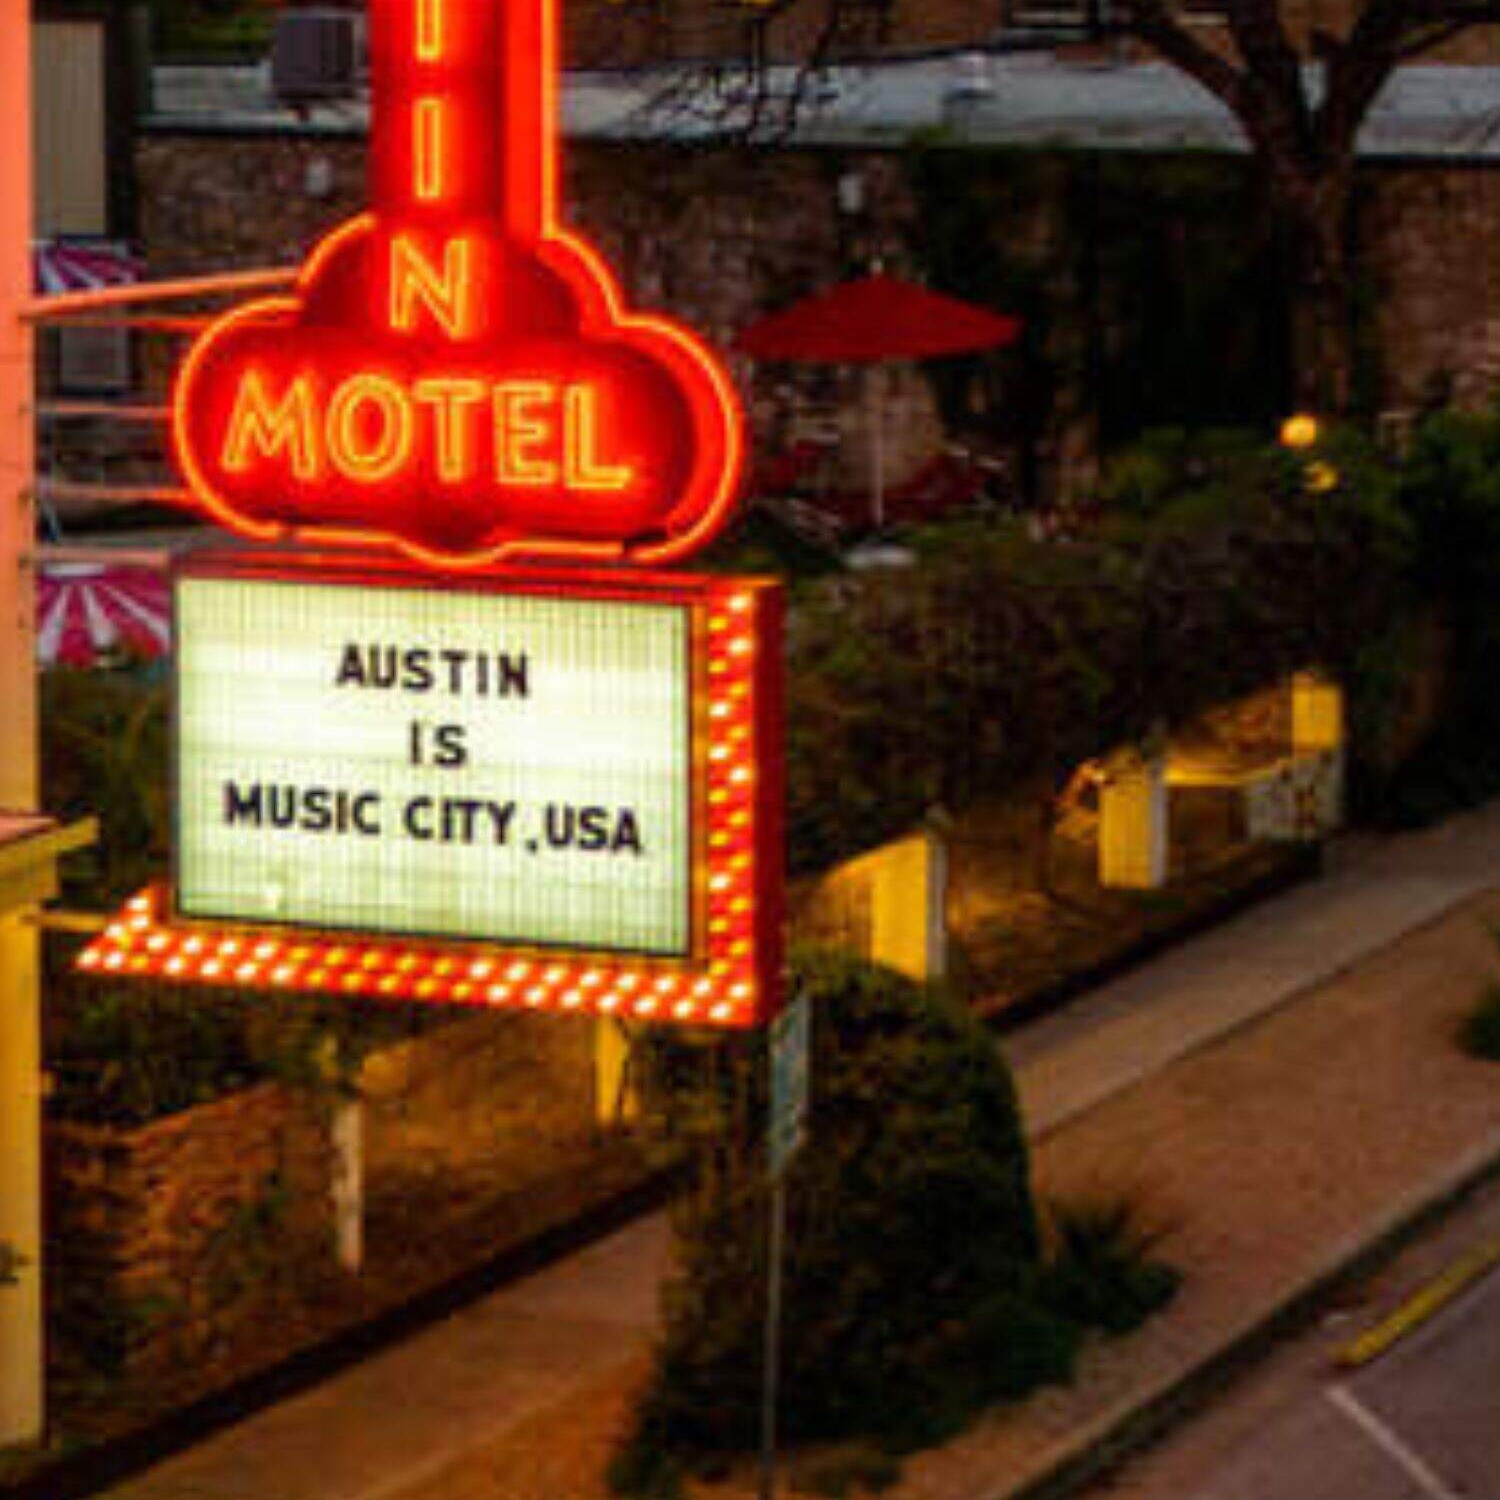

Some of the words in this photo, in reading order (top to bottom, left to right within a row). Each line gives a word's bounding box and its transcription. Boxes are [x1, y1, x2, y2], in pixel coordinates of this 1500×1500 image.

[221, 368, 633, 491] MOTEL
[334, 642, 530, 700] AUSTIN
[409, 719, 469, 769] IS
[223, 780, 382, 836] MUSIC
